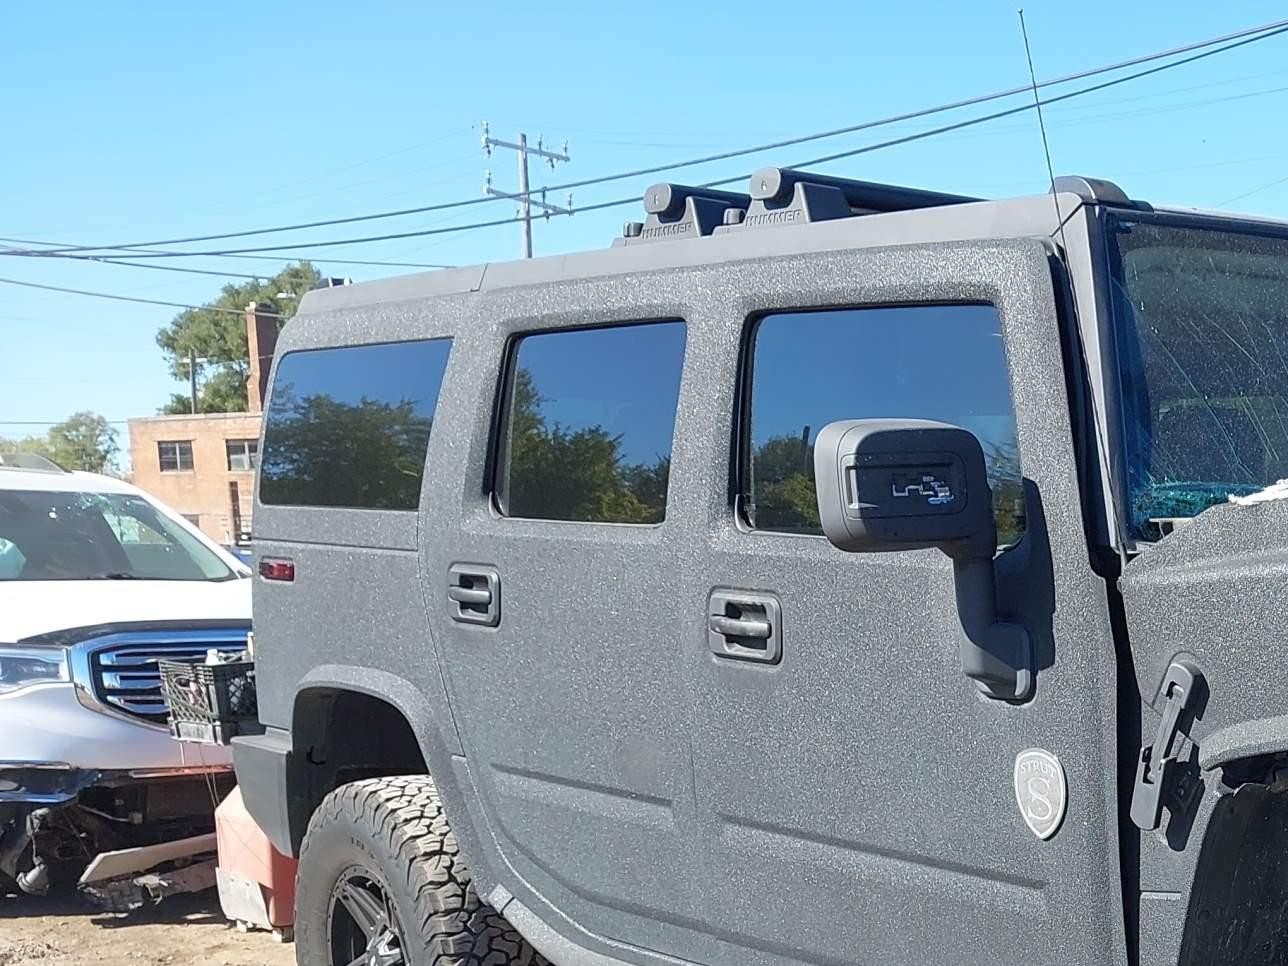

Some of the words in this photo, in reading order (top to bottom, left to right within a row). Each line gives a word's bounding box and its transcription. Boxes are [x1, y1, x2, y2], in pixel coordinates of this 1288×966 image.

[746, 209, 802, 227] HUMMER
[641, 222, 693, 240] HUMMER
[1020, 760, 1057, 778] STRUT
[1027, 776, 1053, 820] S
